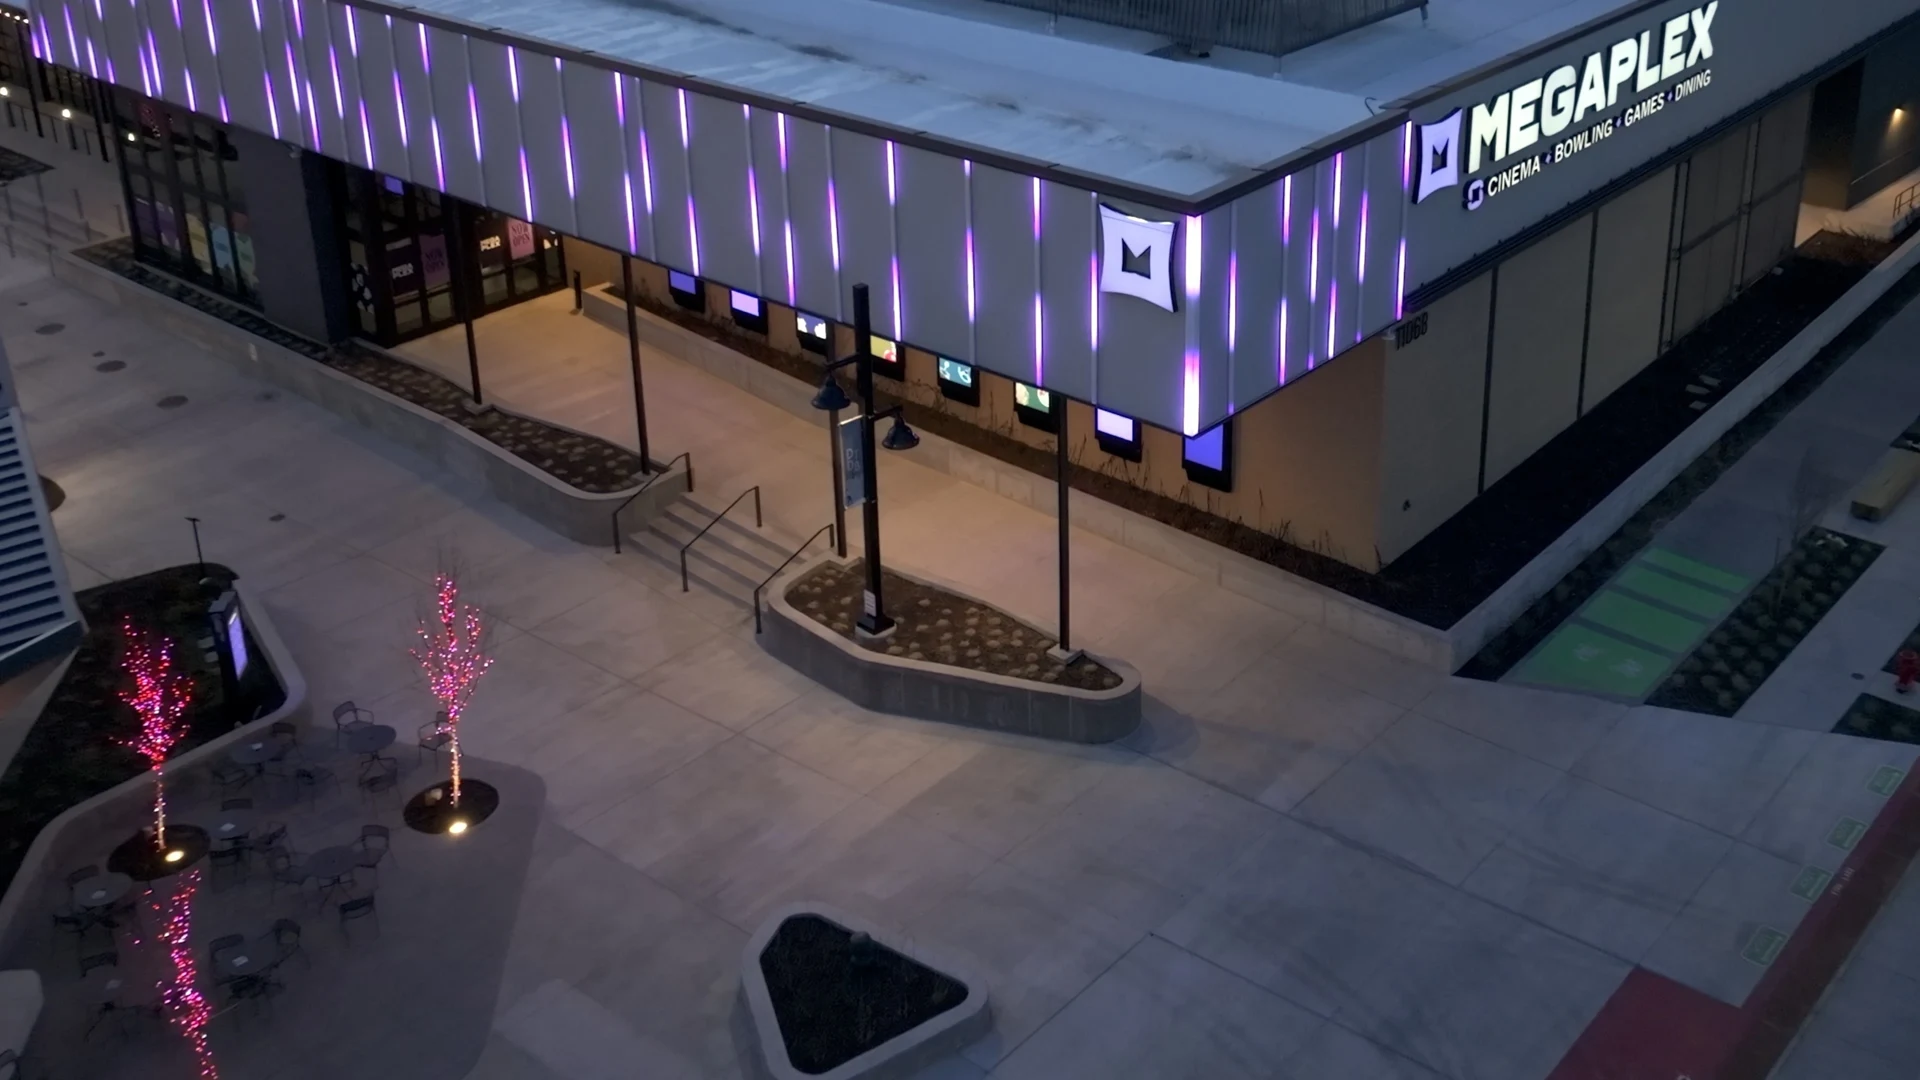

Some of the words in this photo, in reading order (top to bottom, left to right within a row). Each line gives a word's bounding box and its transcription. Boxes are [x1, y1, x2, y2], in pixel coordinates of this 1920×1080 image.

[1467, 1, 1719, 174] MEGAPLEX
[1487, 155, 1540, 196] CINEMA
[1554, 119, 1613, 163] BOWLING
[1624, 93, 1665, 127] GAMES
[1674, 69, 1711, 101] DINING
